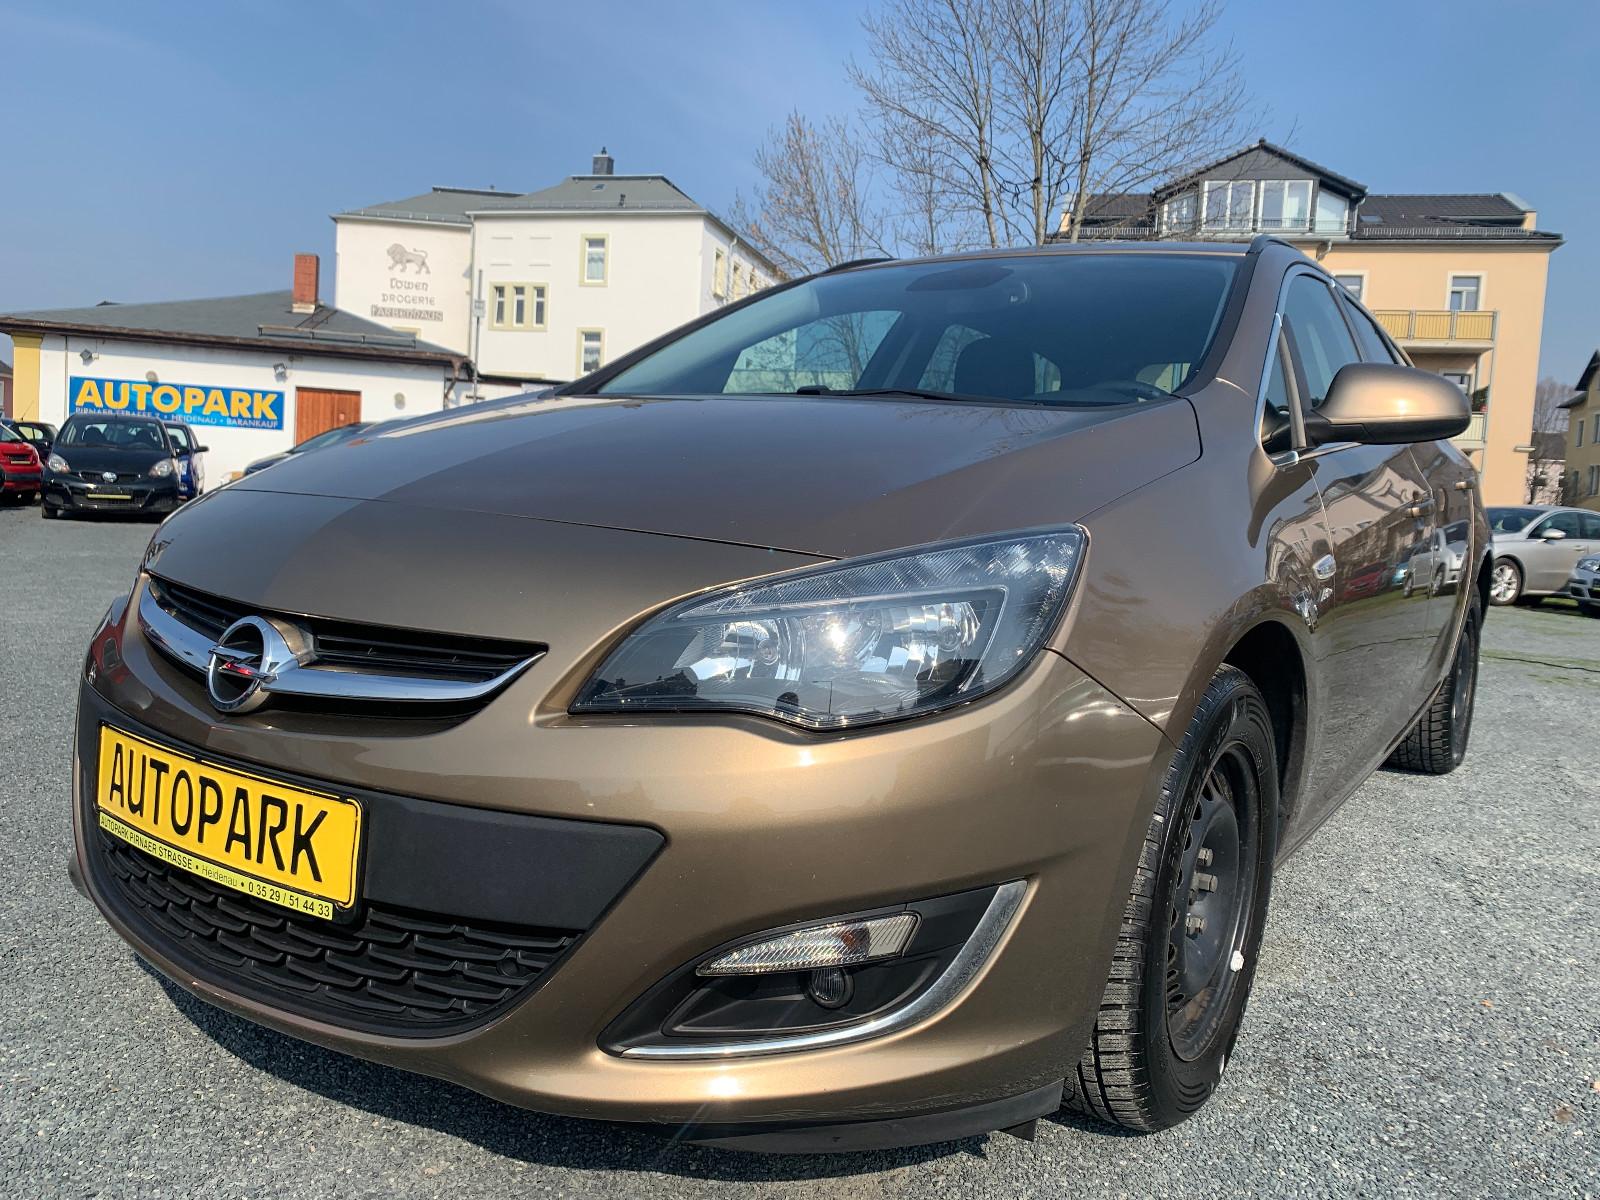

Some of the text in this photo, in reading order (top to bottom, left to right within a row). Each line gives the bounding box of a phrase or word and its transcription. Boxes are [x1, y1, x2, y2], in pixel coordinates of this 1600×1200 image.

[75, 380, 278, 420] AUTOPARK
[171, 413, 217, 425] HEIDENAU
[226, 417, 278, 429] BARANKAUF
[109, 742, 328, 883] AUTOPARK
[100, 816, 129, 839] AUTOPARK
[129, 831, 157, 853] PIRNAER
[158, 845, 193, 870] STRASSE
[201, 864, 238, 887] Heidenau
[248, 881, 254, 893] 0
[256, 884, 267, 898] 35
[269, 888, 281, 902] 29
[289, 896, 299, 908] 51
[302, 899, 315, 913] 44
[317, 903, 330, 917] 33
